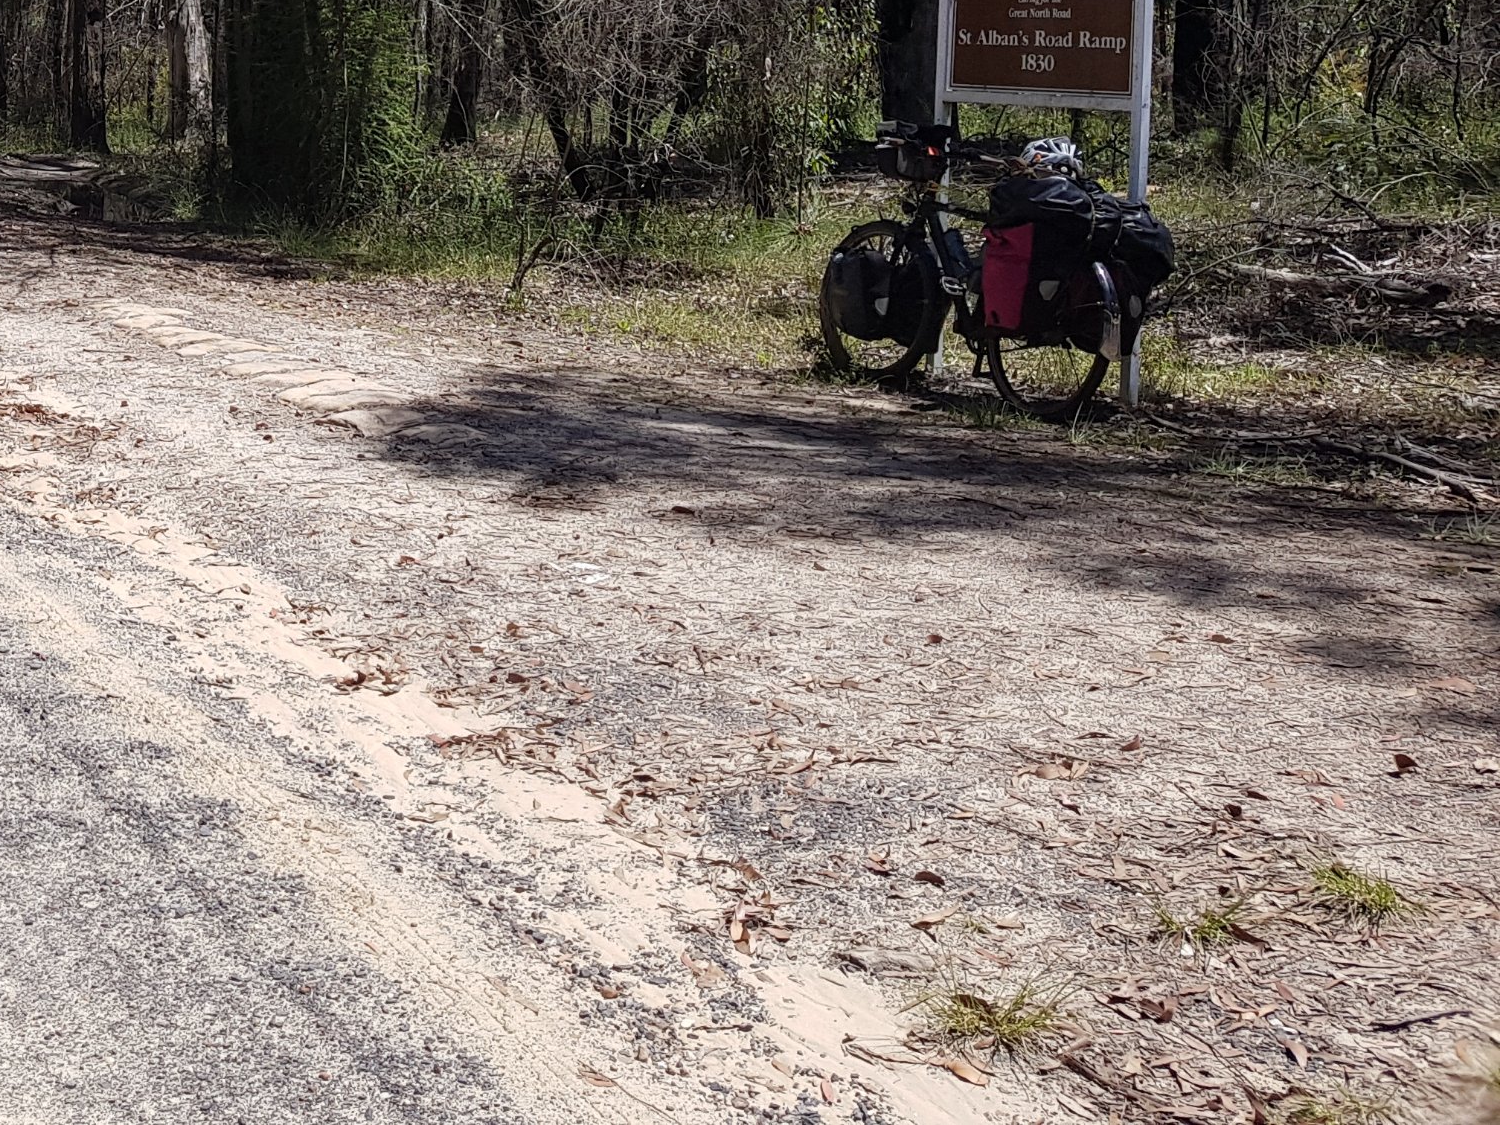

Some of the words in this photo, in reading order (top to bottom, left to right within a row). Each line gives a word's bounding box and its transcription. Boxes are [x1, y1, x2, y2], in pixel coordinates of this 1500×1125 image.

[1009, 8, 1028, 18] Great
[1029, 8, 1050, 18] North
[1052, 8, 1071, 18] Road
[958, 29, 971, 45] St
[976, 30, 1029, 46] Alban's
[1035, 31, 1072, 47] Road
[1079, 31, 1126, 54] Ramp
[1021, 54, 1055, 72] 1830
